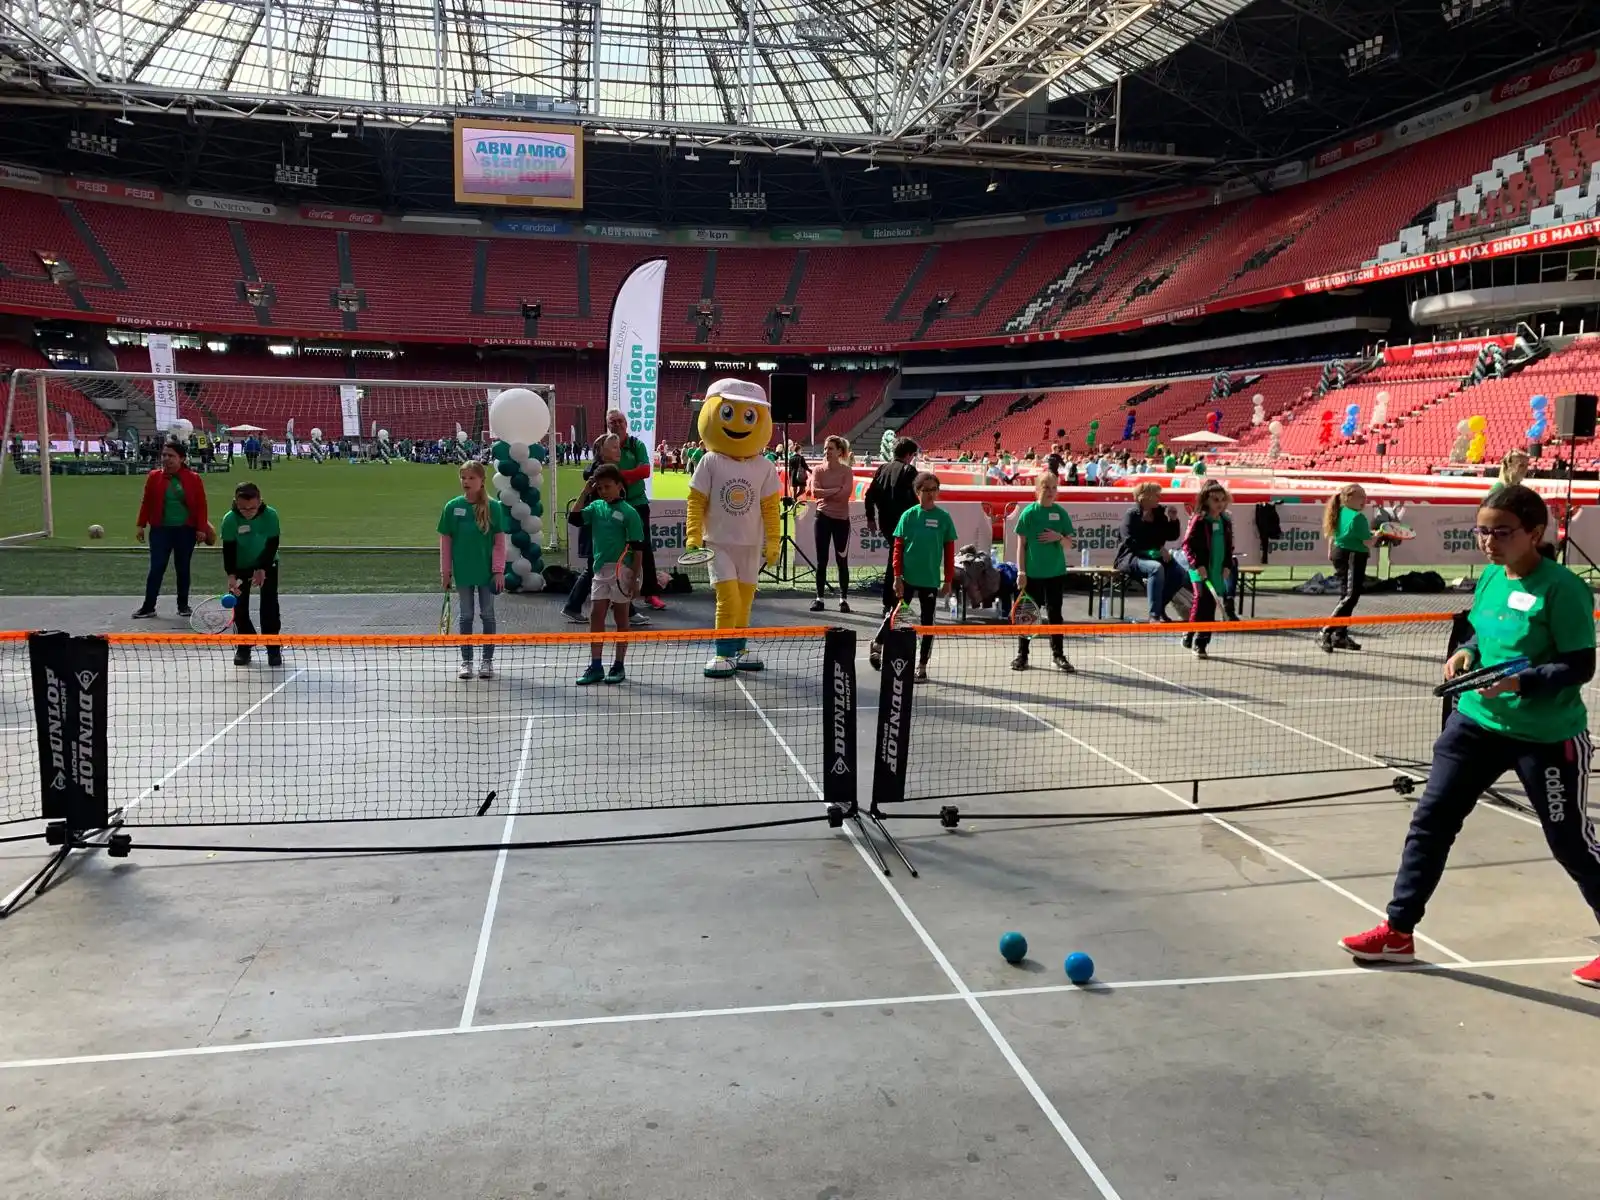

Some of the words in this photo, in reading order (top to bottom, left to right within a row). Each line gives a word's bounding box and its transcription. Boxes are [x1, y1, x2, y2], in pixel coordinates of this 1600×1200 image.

[475, 141, 512, 155] ABN
[515, 143, 567, 158] AMRO
[75, 180, 108, 193] FEBO
[124, 187, 155, 200] FEBO
[521, 223, 556, 233] randstad
[709, 229, 728, 241] kpn
[873, 227, 912, 238] Heineken
[1378, 259, 1427, 276] FOOTBALL
[1429, 250, 1456, 264] CLUB
[1459, 244, 1490, 261] AJAX
[1493, 236, 1529, 253] SINDS
[1533, 232, 1548, 245] 18
[1551, 221, 1600, 241] MAART
[116, 316, 152, 326] EUROPA
[156, 320, 173, 328] CUP
[616, 320, 628, 348] KUNST
[611, 363, 620, 401] CULTUUR
[626, 344, 643, 433] stadion
[44, 666, 65, 771] DUNLOP
[833, 660, 846, 757] DUNLOP
[886, 676, 903, 775] DUNLOP
[79, 690, 95, 798] DUNLOP
[881, 722, 889, 762] SPORT
[1544, 766, 1567, 822] adidas
